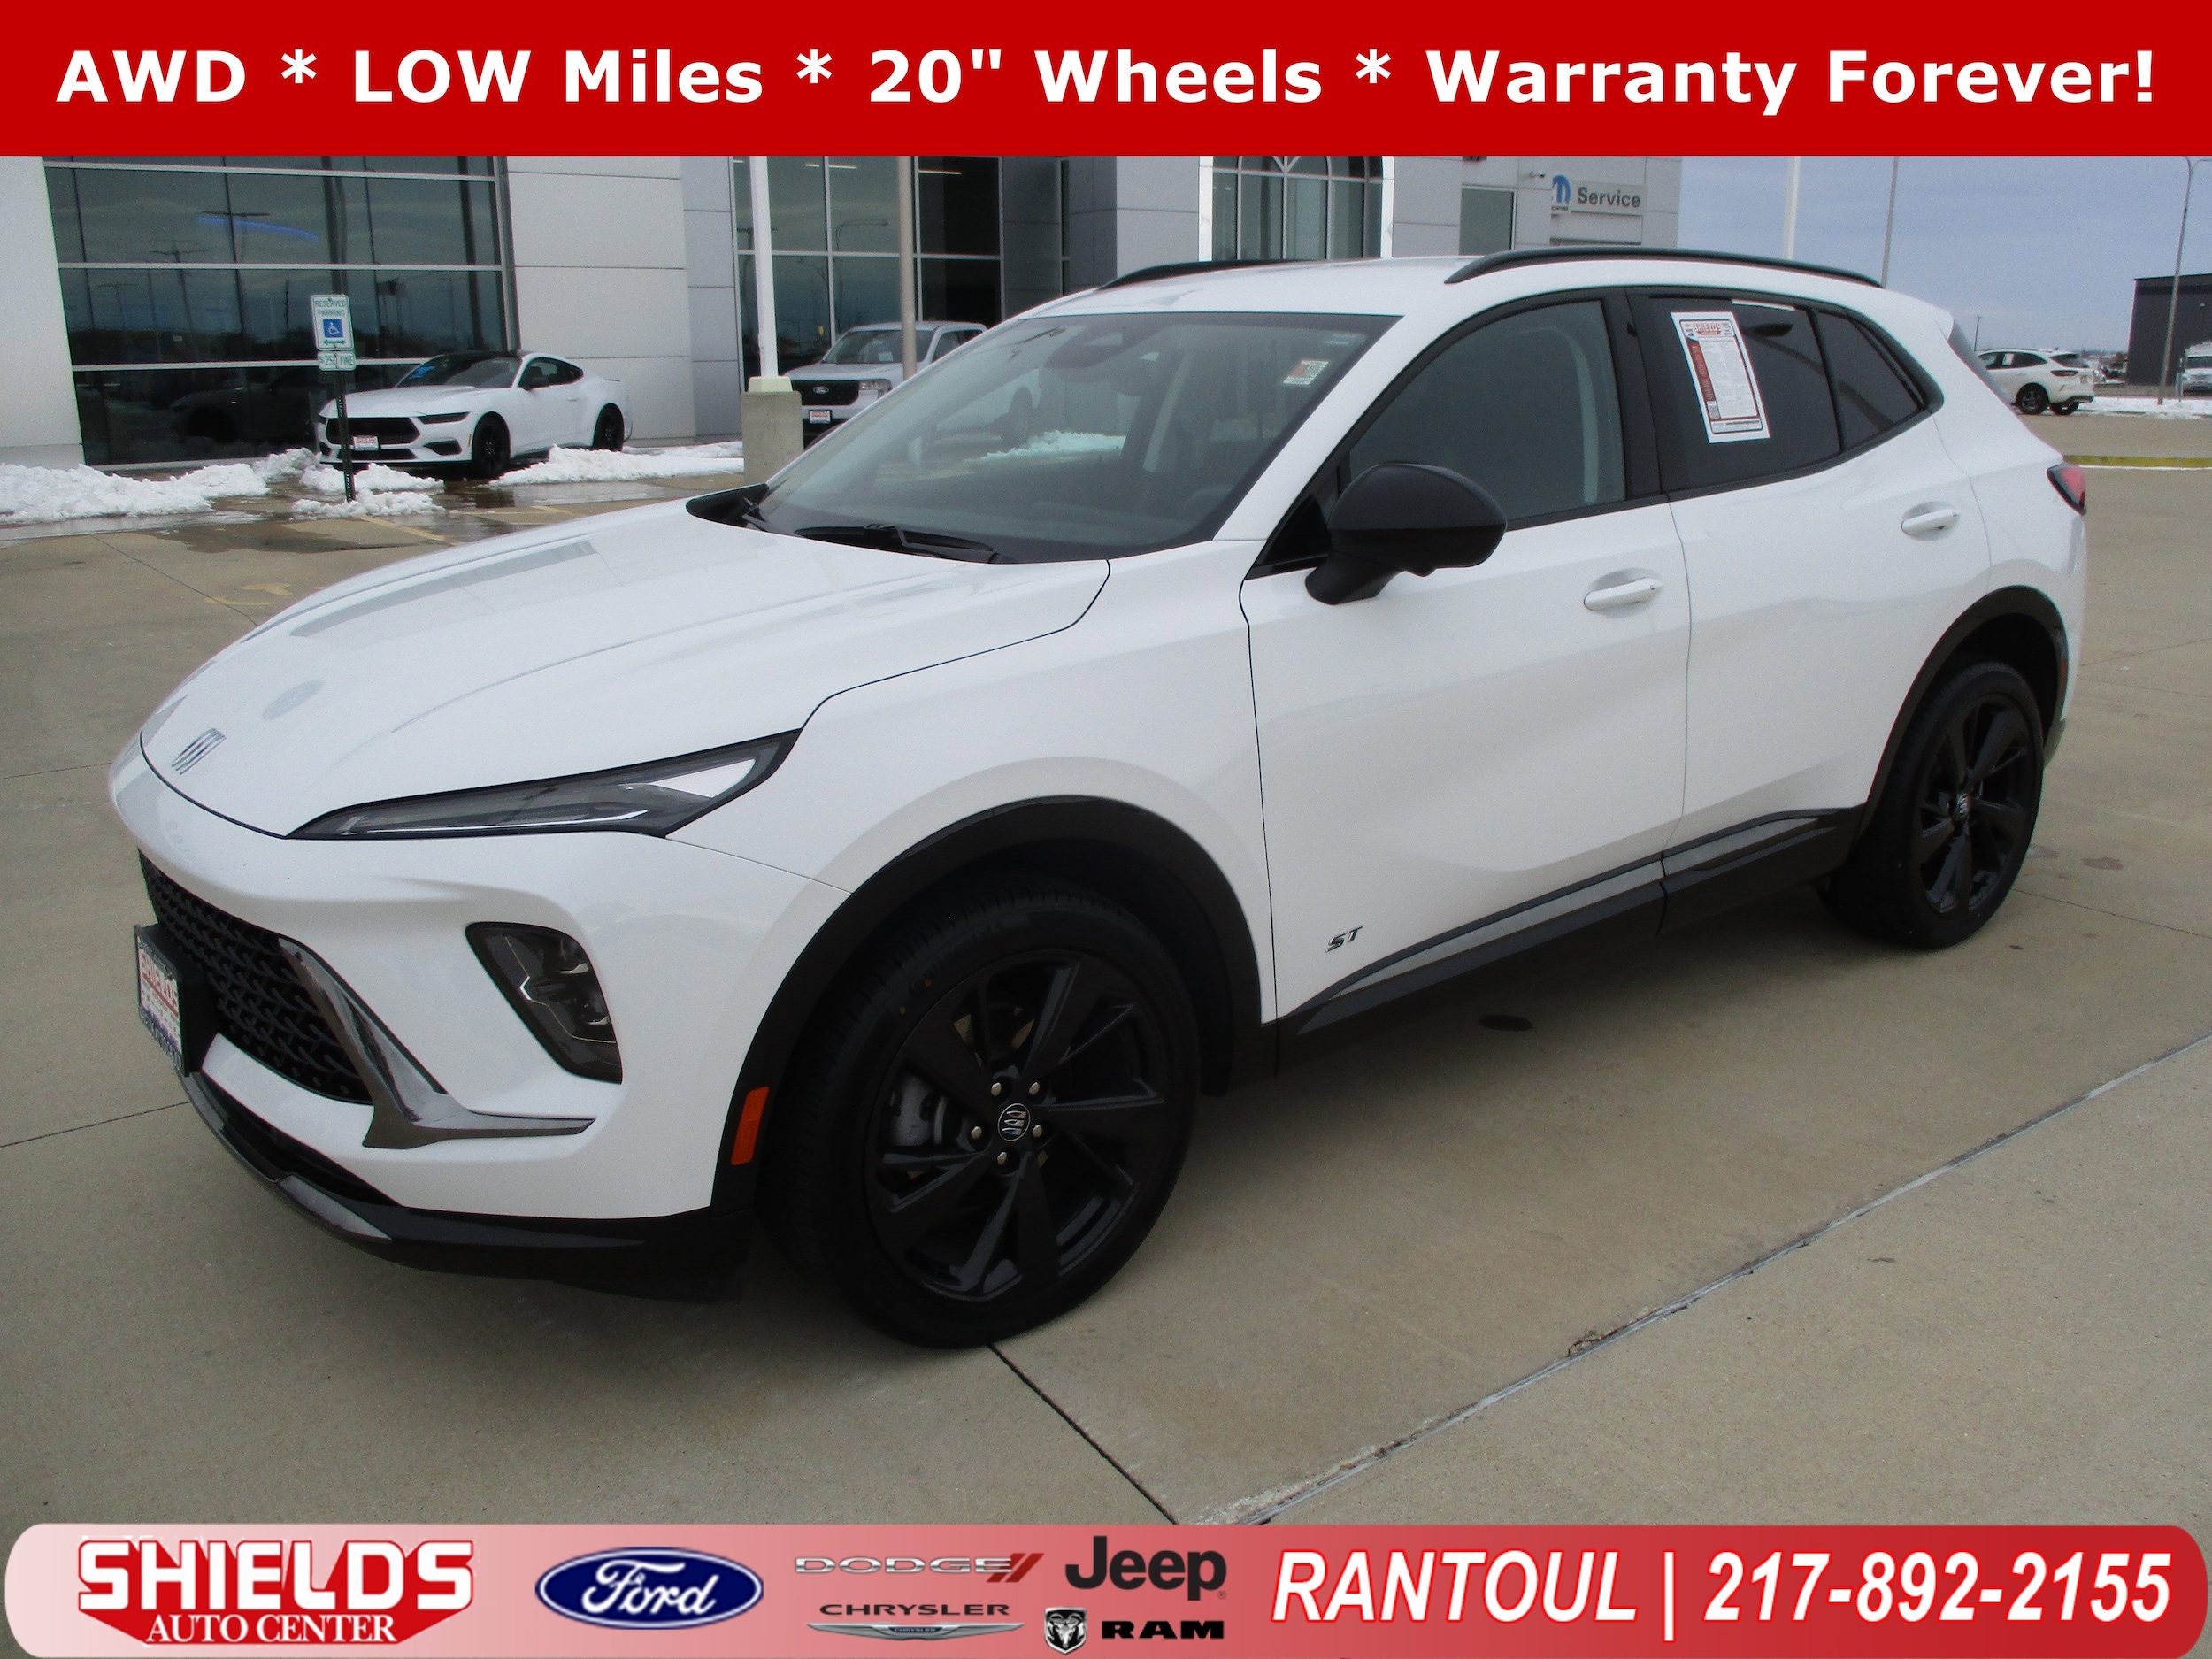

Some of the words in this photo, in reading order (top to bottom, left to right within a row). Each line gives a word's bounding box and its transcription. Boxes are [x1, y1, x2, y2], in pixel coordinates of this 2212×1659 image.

[1578, 187, 1640, 208] Service
[340, 356, 354, 365] FINE
[1325, 926, 1363, 952] ST
